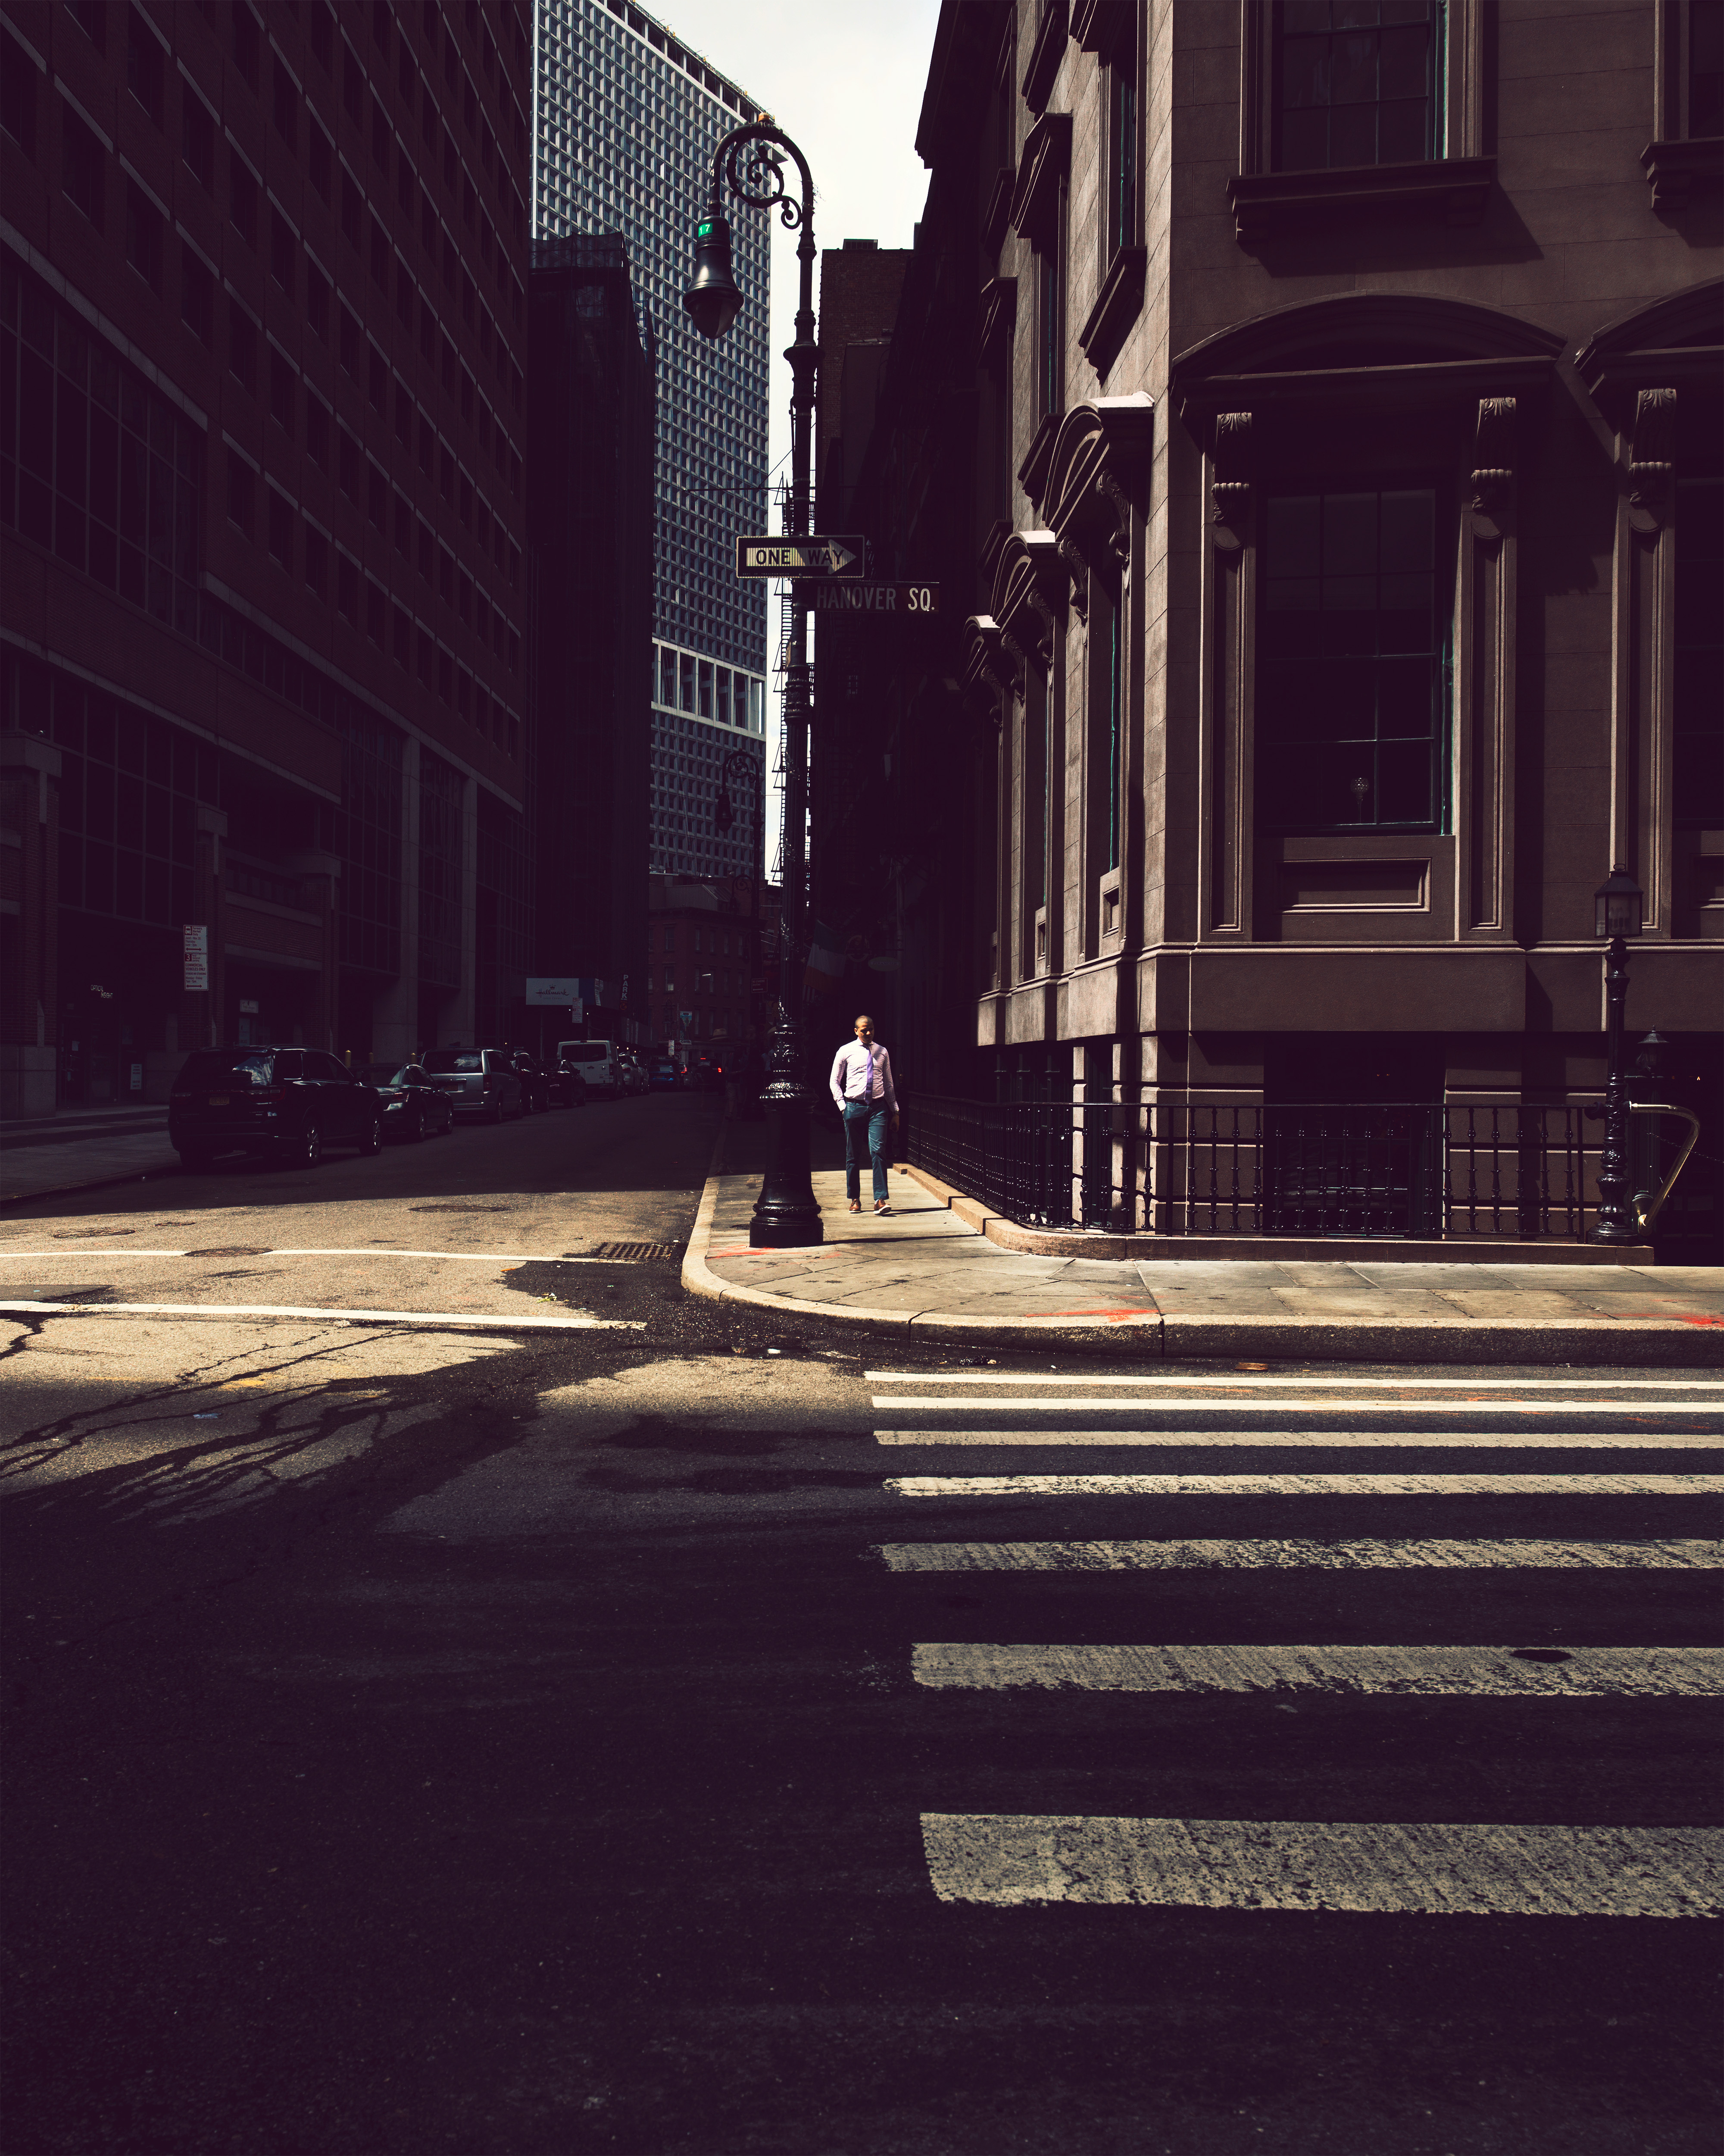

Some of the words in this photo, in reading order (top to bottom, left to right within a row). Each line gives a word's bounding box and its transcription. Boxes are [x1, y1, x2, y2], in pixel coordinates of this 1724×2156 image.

[700, 224, 710, 234] 17
[756, 549, 791, 565] ONE
[808, 549, 844, 565] WAY
[816, 586, 896, 610] HANOVER
[908, 588, 934, 611] SQ.
[535, 988, 569, 998] Hallmark
